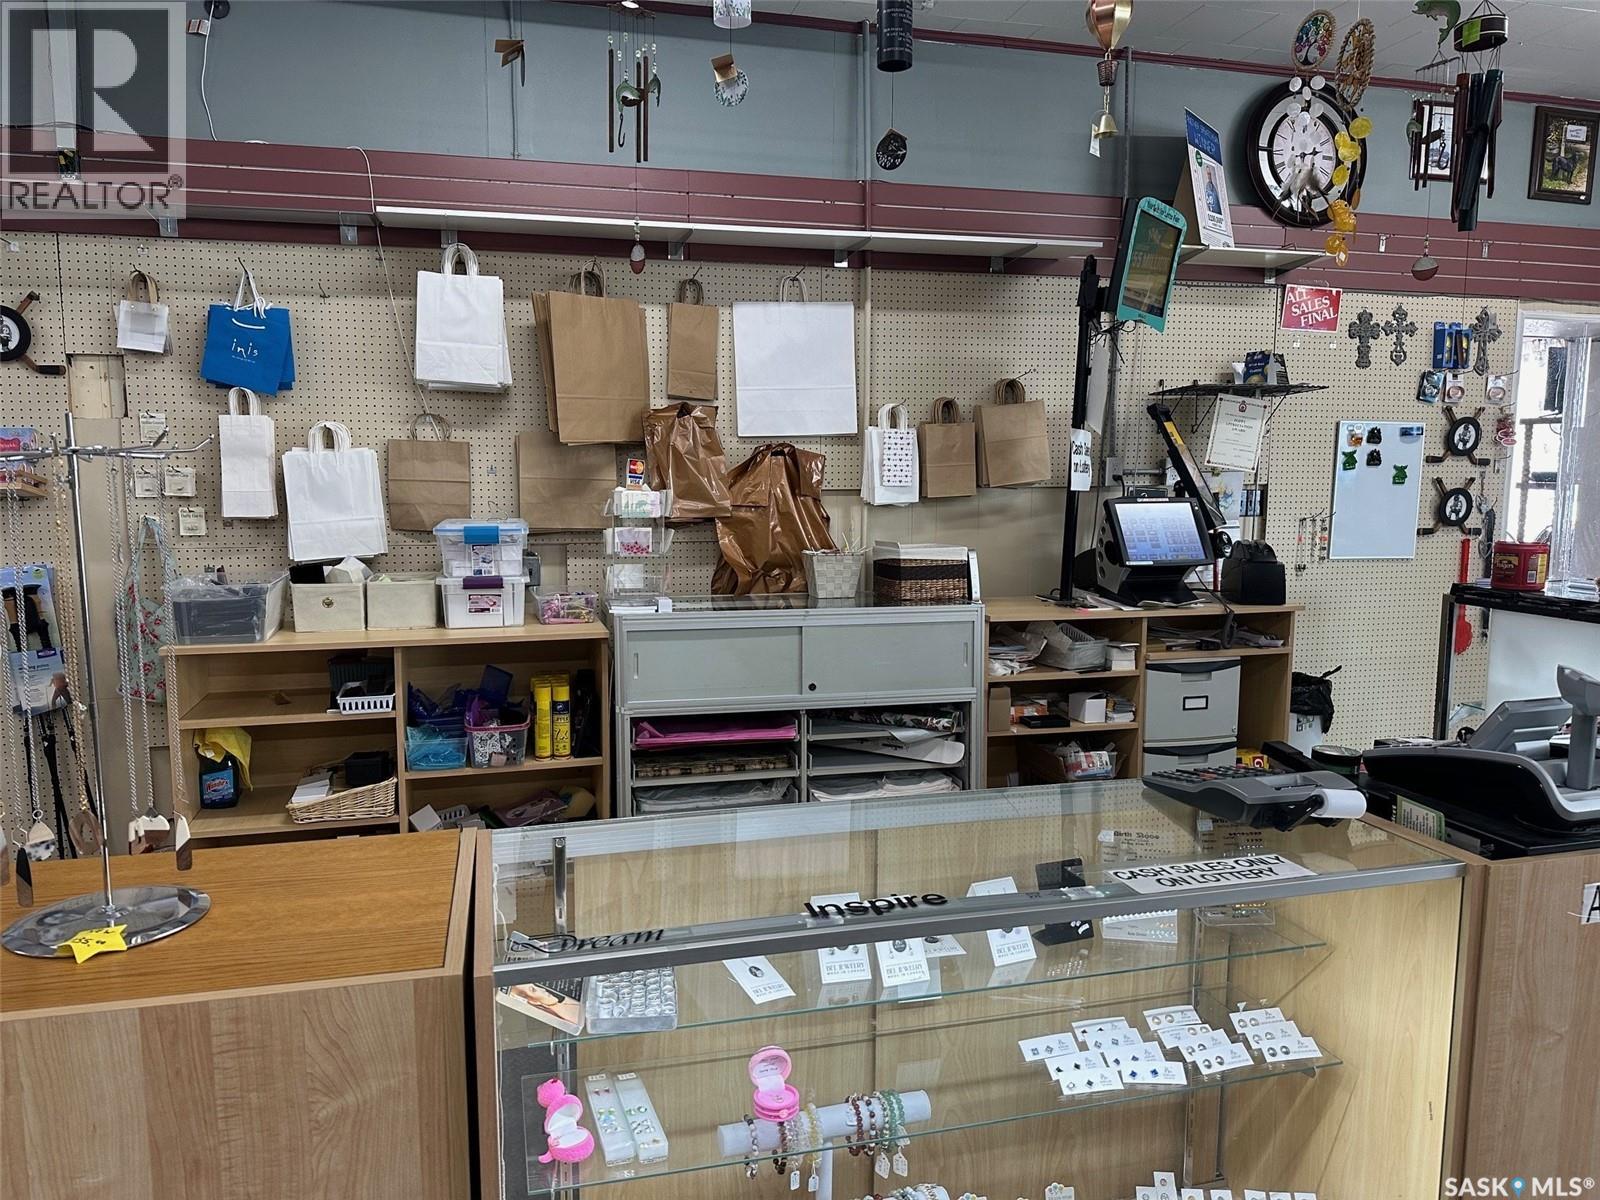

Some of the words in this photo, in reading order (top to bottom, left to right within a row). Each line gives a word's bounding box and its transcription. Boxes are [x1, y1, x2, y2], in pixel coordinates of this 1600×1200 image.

[1287, 290, 1310, 305] ALL
[1291, 295, 1330, 316] SALES
[1300, 307, 1337, 327] FINAL
[1112, 866, 1173, 881] CASH
[1170, 860, 1234, 875] SALES
[1233, 854, 1288, 868] ONLY
[1155, 874, 1193, 888] ON
[1191, 866, 1280, 884] LOTTERY
[804, 893, 948, 919] Inspire
[510, 928, 665, 954] Dream
